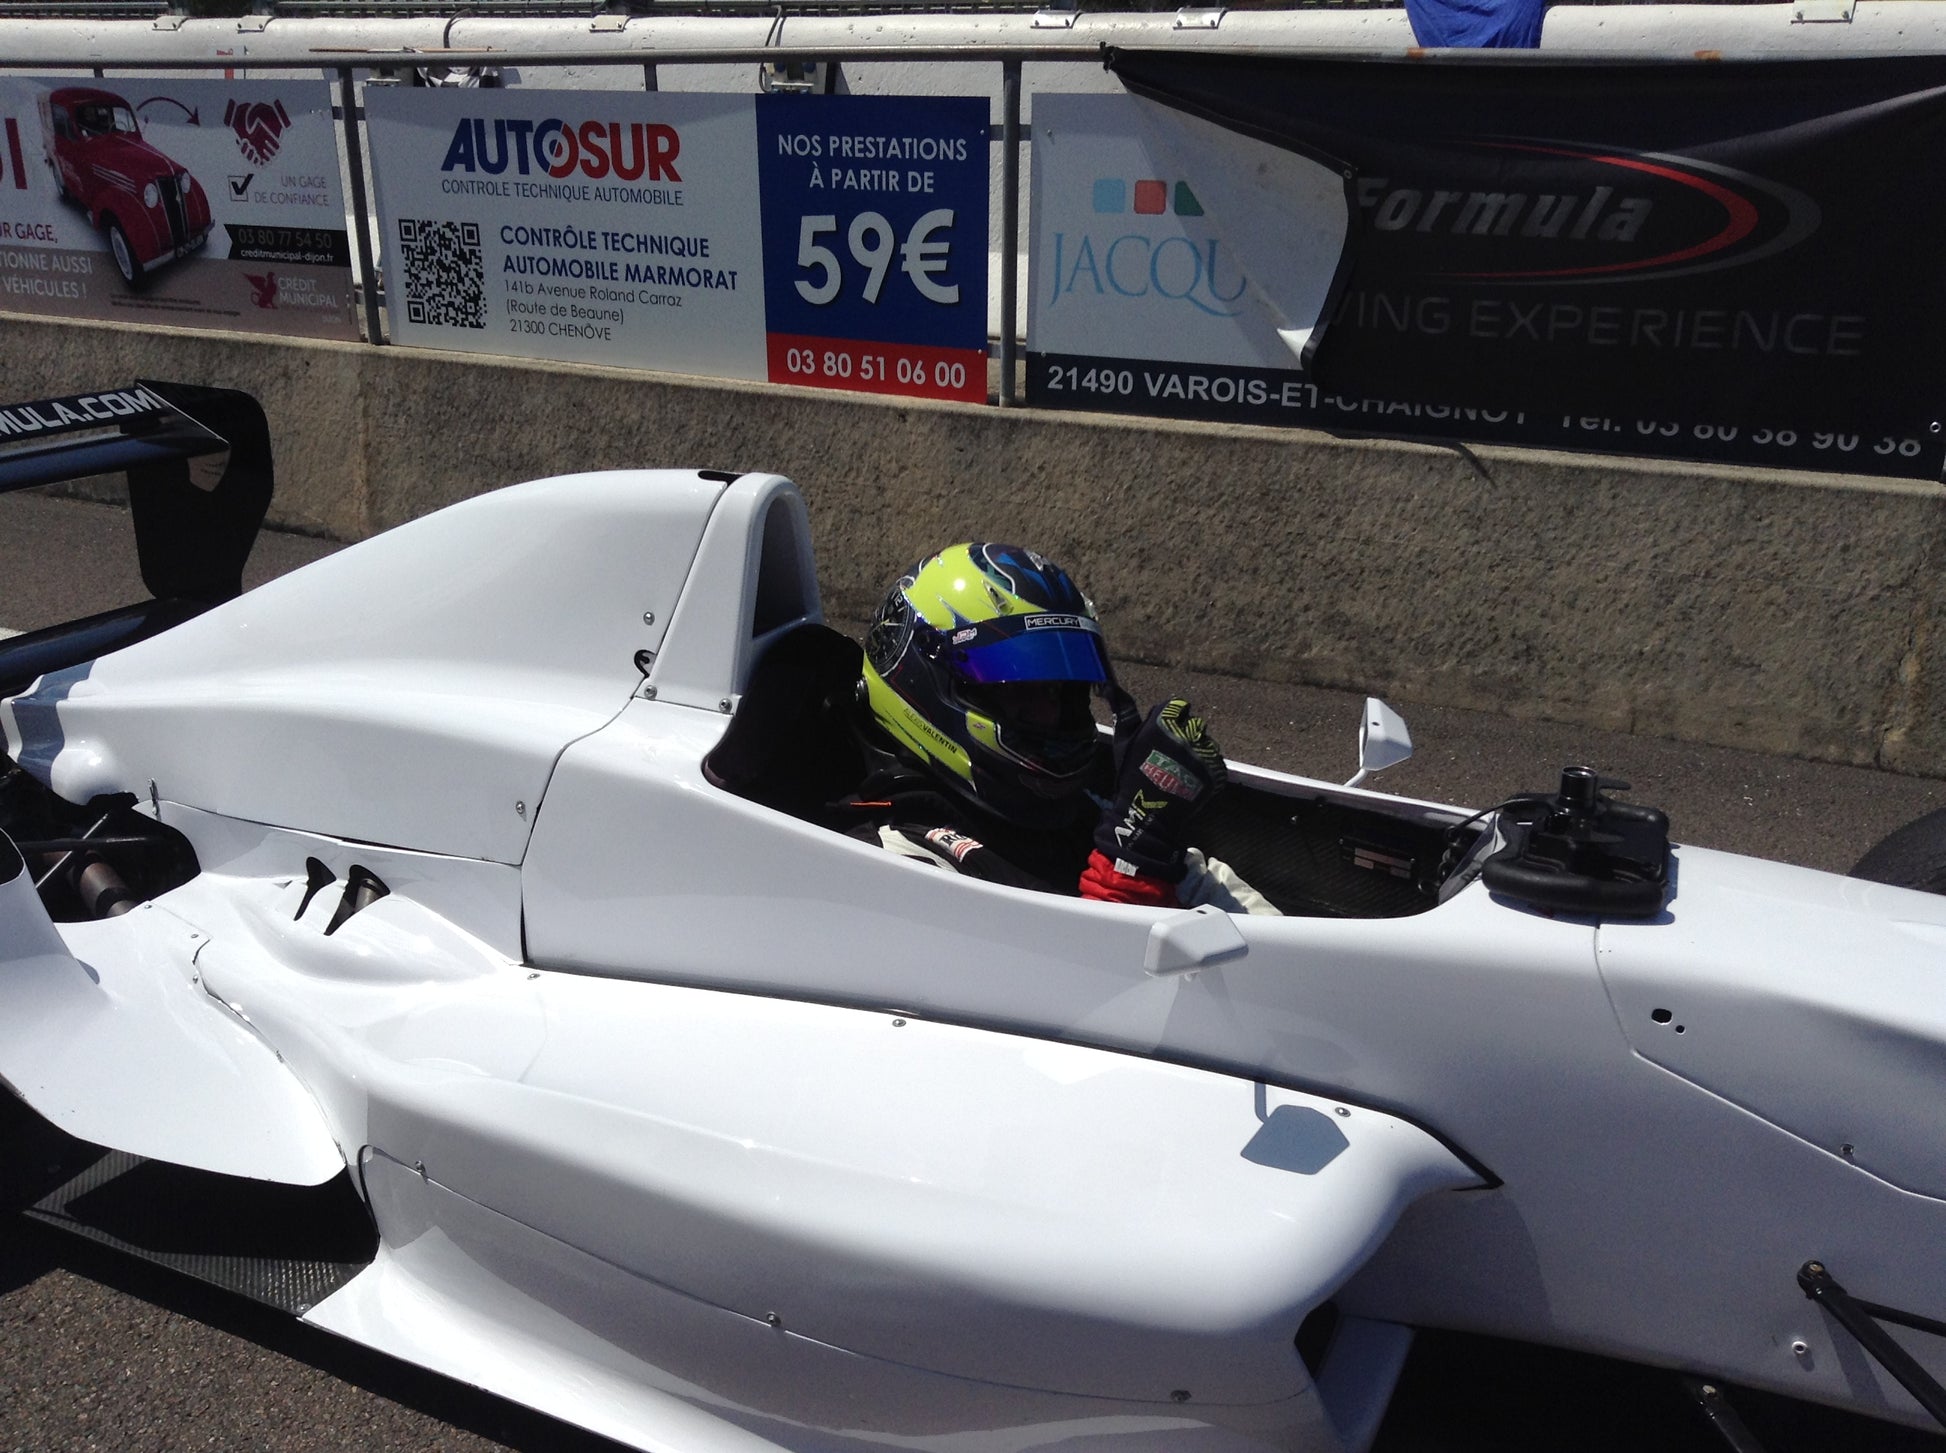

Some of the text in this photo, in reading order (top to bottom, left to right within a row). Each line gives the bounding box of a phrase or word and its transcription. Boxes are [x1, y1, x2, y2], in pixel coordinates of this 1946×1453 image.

[441, 118, 683, 183] AUTOSUR
[778, 134, 968, 161] NOS PRESTATIONS
[280, 175, 327, 189] UN GAGE
[809, 161, 934, 193] À PARTIR DE
[254, 191, 330, 207] DE CONFIANCE
[441, 179, 684, 206] CONTROLE TECHNIQUE AUTOMOBILE
[1357, 177, 1654, 243] Formula
[15, 223, 58, 244] GAGE,
[238, 228, 332, 249] 03 80 77 54 50
[500, 224, 710, 258] CONTRÔLE TECHNIQUE
[52, 255, 93, 274] AUSSI
[794, 208, 960, 306] 59€
[3, 274, 79, 299] VÉHICULES
[278, 276, 317, 293] CRÉDIT
[503, 255, 738, 291] AUTOMOBILE MARMORAT
[280, 292, 338, 308] MUNICIPAL
[504, 280, 682, 308] 141b Avenue Roland Carraz
[506, 299, 625, 325] (Route de Beaune)
[509, 318, 612, 341] 21300 CHENÔVE
[1469, 299, 1867, 356] EXPERIENCE
[787, 348, 966, 389] 03 80 51 06 00
[1047, 365, 1134, 395] 21490
[1027, 616, 1080, 629] MERCURY
